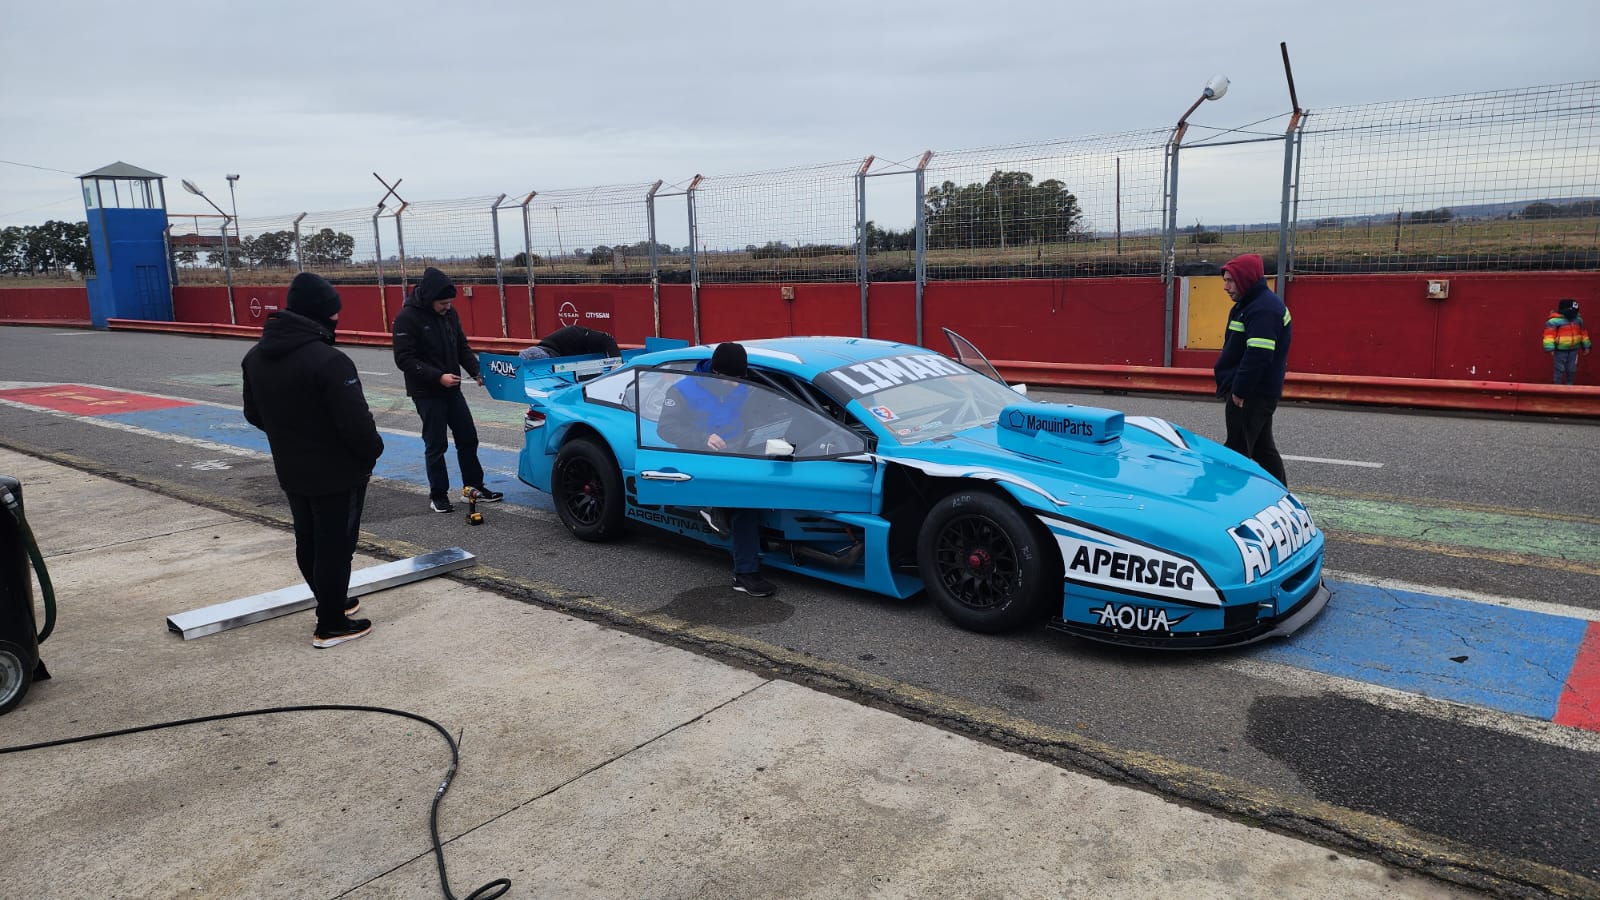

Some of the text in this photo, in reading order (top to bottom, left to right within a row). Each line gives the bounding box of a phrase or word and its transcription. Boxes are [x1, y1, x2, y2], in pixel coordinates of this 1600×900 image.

[488, 360, 517, 377] AQUA
[627, 507, 700, 532] ARGENTINA
[1069, 545, 1194, 591] APERSEG
[1096, 602, 1173, 632] AQUA
